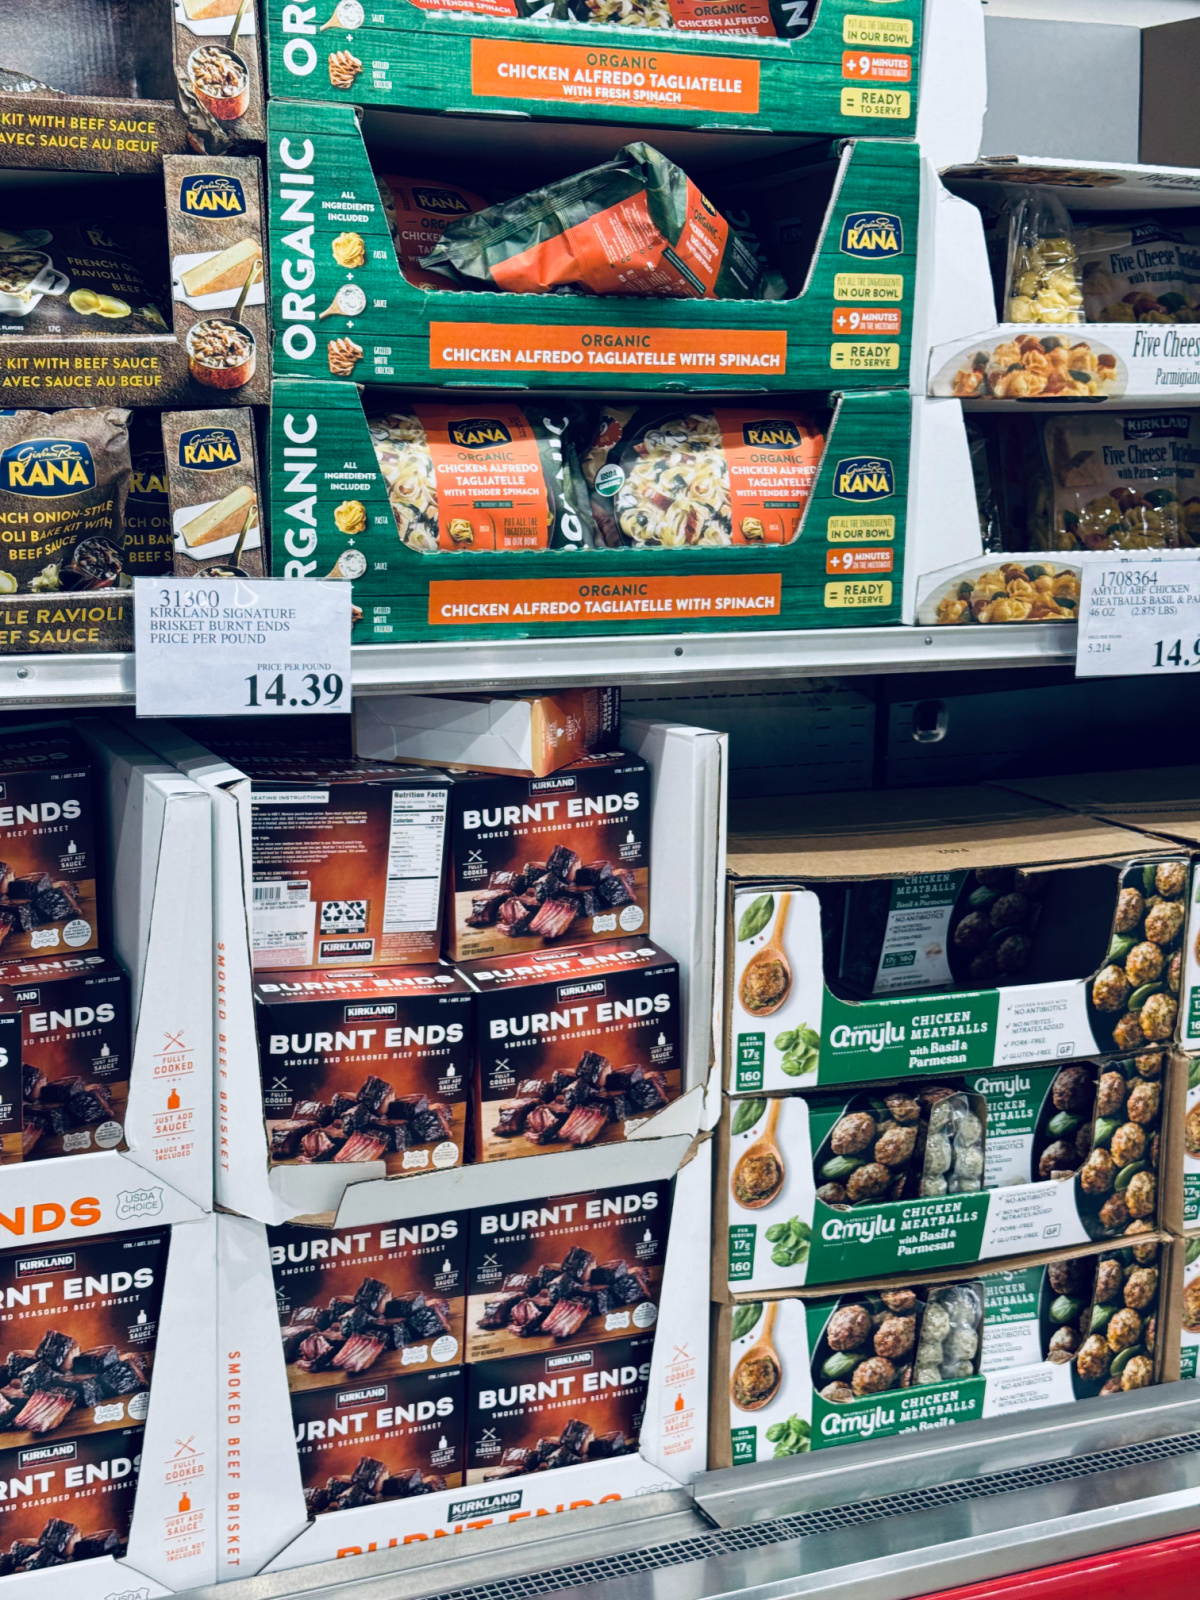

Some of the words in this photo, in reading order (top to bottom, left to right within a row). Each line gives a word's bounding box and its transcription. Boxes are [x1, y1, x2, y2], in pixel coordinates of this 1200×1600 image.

[694, 4, 747, 16] ORGANIC
[677, 18, 722, 29] CHICKEN
[724, 15, 769, 26] ALFREDO
[848, 31, 858, 39] IN
[860, 32, 880, 42] OUR
[883, 34, 909, 44] BOWL
[586, 53, 657, 69] ORGANIC
[872, 58, 908, 68] MINUTES
[498, 63, 569, 81] CHICKEN
[574, 68, 645, 86] ALFREDO
[649, 74, 743, 93] TAGLIATELLE
[563, 85, 592, 96] WITH
[595, 88, 631, 100] FRESH
[633, 90, 682, 103] SPINACH
[861, 93, 902, 105] READY
[860, 105, 872, 114] TO
[874, 105, 902, 115] SERVE
[2, 113, 24, 126] KIT
[29, 114, 67, 129] WITH
[71, 117, 104, 131] BEEF
[109, 119, 156, 134] SAUCE
[186, 190, 242, 212] RANA
[341, 191, 355, 199] ALL
[321, 202, 375, 212] INGREDIENTS
[327, 213, 369, 223] INCLUDED
[847, 230, 898, 250] RANA
[279, 137, 318, 360] ORGANIC
[580, 334, 651, 348] ORGANIC
[1132, 330, 1161, 358] Five
[442, 348, 512, 363] CHICKEN
[514, 349, 584, 365] ALFREDO
[588, 350, 677, 367] TAGLIATELLE
[679, 352, 717, 367] WITH
[719, 353, 781, 368] SPINACH
[851, 346, 891, 357] READY
[7, 358, 28, 369] KIT
[31, 357, 68, 370] WITH
[72, 357, 107, 370] BEEF
[112, 357, 158, 370] SAUCE
[850, 359, 860, 367] TO
[864, 359, 891, 367] SERVE
[2, 376, 41, 388] AVEC
[44, 376, 92, 388] SAUCE
[96, 376, 116, 388] AU
[120, 376, 162, 388] BŒUF
[1128, 417, 1188, 430] KIRKLAND
[453, 428, 507, 445] RANA
[748, 430, 798, 446] RANA
[184, 444, 237, 464] RANA
[457, 452, 515, 462] ORGANIC
[9, 460, 90, 486] RANA
[437, 464, 488, 473] CHICKEN
[489, 463, 539, 473] ALFREDO
[456, 476, 525, 486] TAGLIATELLE
[839, 473, 890, 494] RANA
[443, 488, 466, 497] WITH
[468, 488, 501, 496] TENDER
[503, 488, 540, 496] SPINACH
[33, 500, 113, 524] ONION-STYLE
[31, 526, 60, 542] BAKE
[63, 521, 82, 534] KIT
[84, 519, 112, 530] WITH
[9, 545, 42, 560] BEEF
[45, 534, 77, 555] SAUCE
[1100, 571, 1158, 587] 1708364
[579, 583, 648, 597] ORGANIC
[1091, 585, 1126, 595] AMYLU
[1128, 585, 1147, 595] ABF
[1150, 585, 1190, 594] CHICKEN
[159, 589, 220, 608] 31300
[441, 604, 509, 617] CHICKEN
[513, 602, 581, 616] ALFREDO
[585, 598, 673, 614] TAGLIATELLE
[675, 597, 713, 612] WITH
[715, 596, 775, 611] SPINACH
[1091, 595, 1146, 606] MEATBALLS
[1149, 595, 1175, 605] BASIL
[36, 607, 123, 624] RAVIOLI
[150, 608, 219, 619] KIRKLAND
[223, 608, 296, 619] SIGNATURE
[1089, 607, 1100, 617] 46
[1102, 607, 1115, 616] OZ
[1131, 607, 1155, 616] (2.875
[1157, 606, 1177, 616] LBS)
[150, 620, 205, 631] BRISKET
[209, 620, 253, 631] BURNT
[256, 621, 290, 631] ENDS
[28, 628, 100, 643] SAUCE
[150, 633, 189, 644] PRICE
[193, 633, 217, 644] PER
[221, 633, 266, 644] POUND
[1087, 643, 1111, 653] 5.214
[257, 663, 282, 671] PRICE
[244, 673, 343, 706] 14.39
[531, 778, 574, 790] KIRKLAND
[430, 815, 444, 823] 270
[463, 801, 560, 830] BURNT
[567, 792, 640, 818] ENDS
[217, 941, 227, 1021] SMOKED
[348, 1006, 395, 1016] KIRKLAND
[489, 1006, 589, 1039] BURNT
[596, 993, 671, 1023] ENDS
[1025, 1004, 1067, 1014] ANTIBIOTICS
[29, 1003, 115, 1033] ENDS
[912, 1011, 971, 1026] CHICKEN
[269, 1029, 377, 1055] BURNT
[385, 1023, 464, 1048] ENDS
[911, 1022, 988, 1040] MEATBALLS
[909, 1046, 929, 1056] with
[930, 1040, 960, 1054] Basil
[960, 1042, 968, 1050] &
[1011, 1037, 1046, 1047] PORK-FREE
[1059, 1045, 1071, 1054] GF
[162, 1054, 186, 1064] FULLY
[219, 1032, 227, 1080] BEEF
[742, 1049, 760, 1060] 17g
[909, 1054, 966, 1069] Parmesan
[1009, 1048, 1052, 1059] GLUTEN-FREE
[154, 1061, 193, 1075] COOKED
[739, 1071, 761, 1082] 160
[220, 1091, 229, 1171] BRISKET
[125, 1192, 155, 1203] USDA
[121, 1201, 159, 1213] CHOICE
[480, 1203, 578, 1235] BURNT
[585, 1191, 658, 1219] ENDS
[902, 1202, 962, 1218] CHICKEN
[900, 1211, 978, 1231] MEATBALLS
[380, 1219, 458, 1249] ENDS
[899, 1235, 918, 1245] with
[919, 1228, 948, 1242] Basil
[897, 1240, 955, 1256] Parmesan
[20, 1256, 73, 1271] KIRKLAND
[63, 1268, 154, 1300] ENDS
[228, 1351, 241, 1424] SMOKED
[478, 1377, 576, 1409] BURNT
[901, 1390, 959, 1410] CHICKEN
[376, 1396, 454, 1429] ENDS
[899, 1399, 976, 1422] MEATBALLS
[227, 1437, 241, 1479] BEEF
[452, 1493, 520, 1515] KIRKLAND
[227, 1492, 241, 1566] BRISKET
